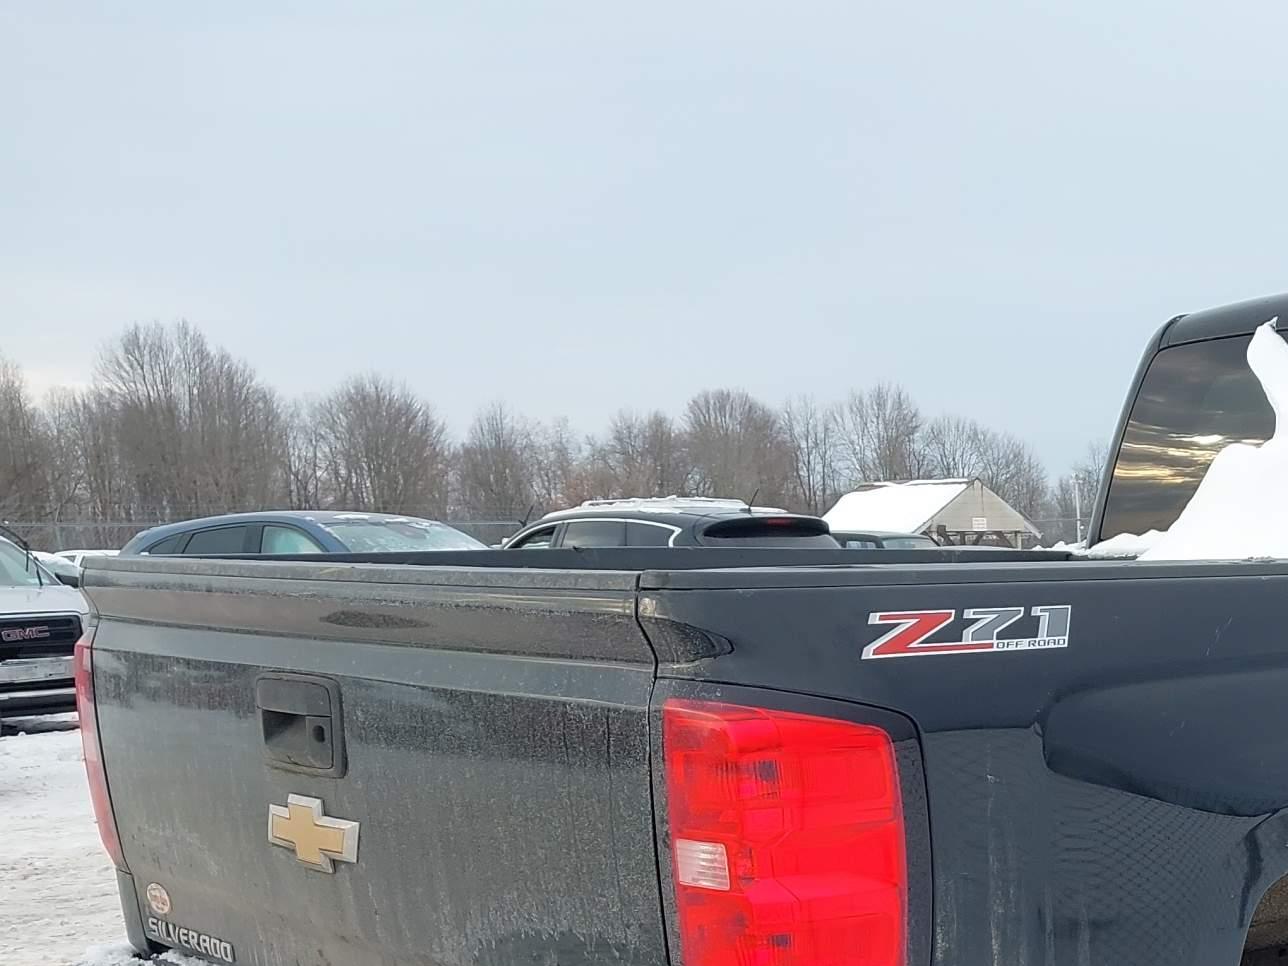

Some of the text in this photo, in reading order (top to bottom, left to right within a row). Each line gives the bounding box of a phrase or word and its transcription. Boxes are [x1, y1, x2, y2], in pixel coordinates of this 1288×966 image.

[1, 625, 50, 642] GMC
[861, 604, 1072, 660] Z71
[995, 637, 1066, 650] OFF ROAD
[148, 916, 234, 963] SILVERADO
